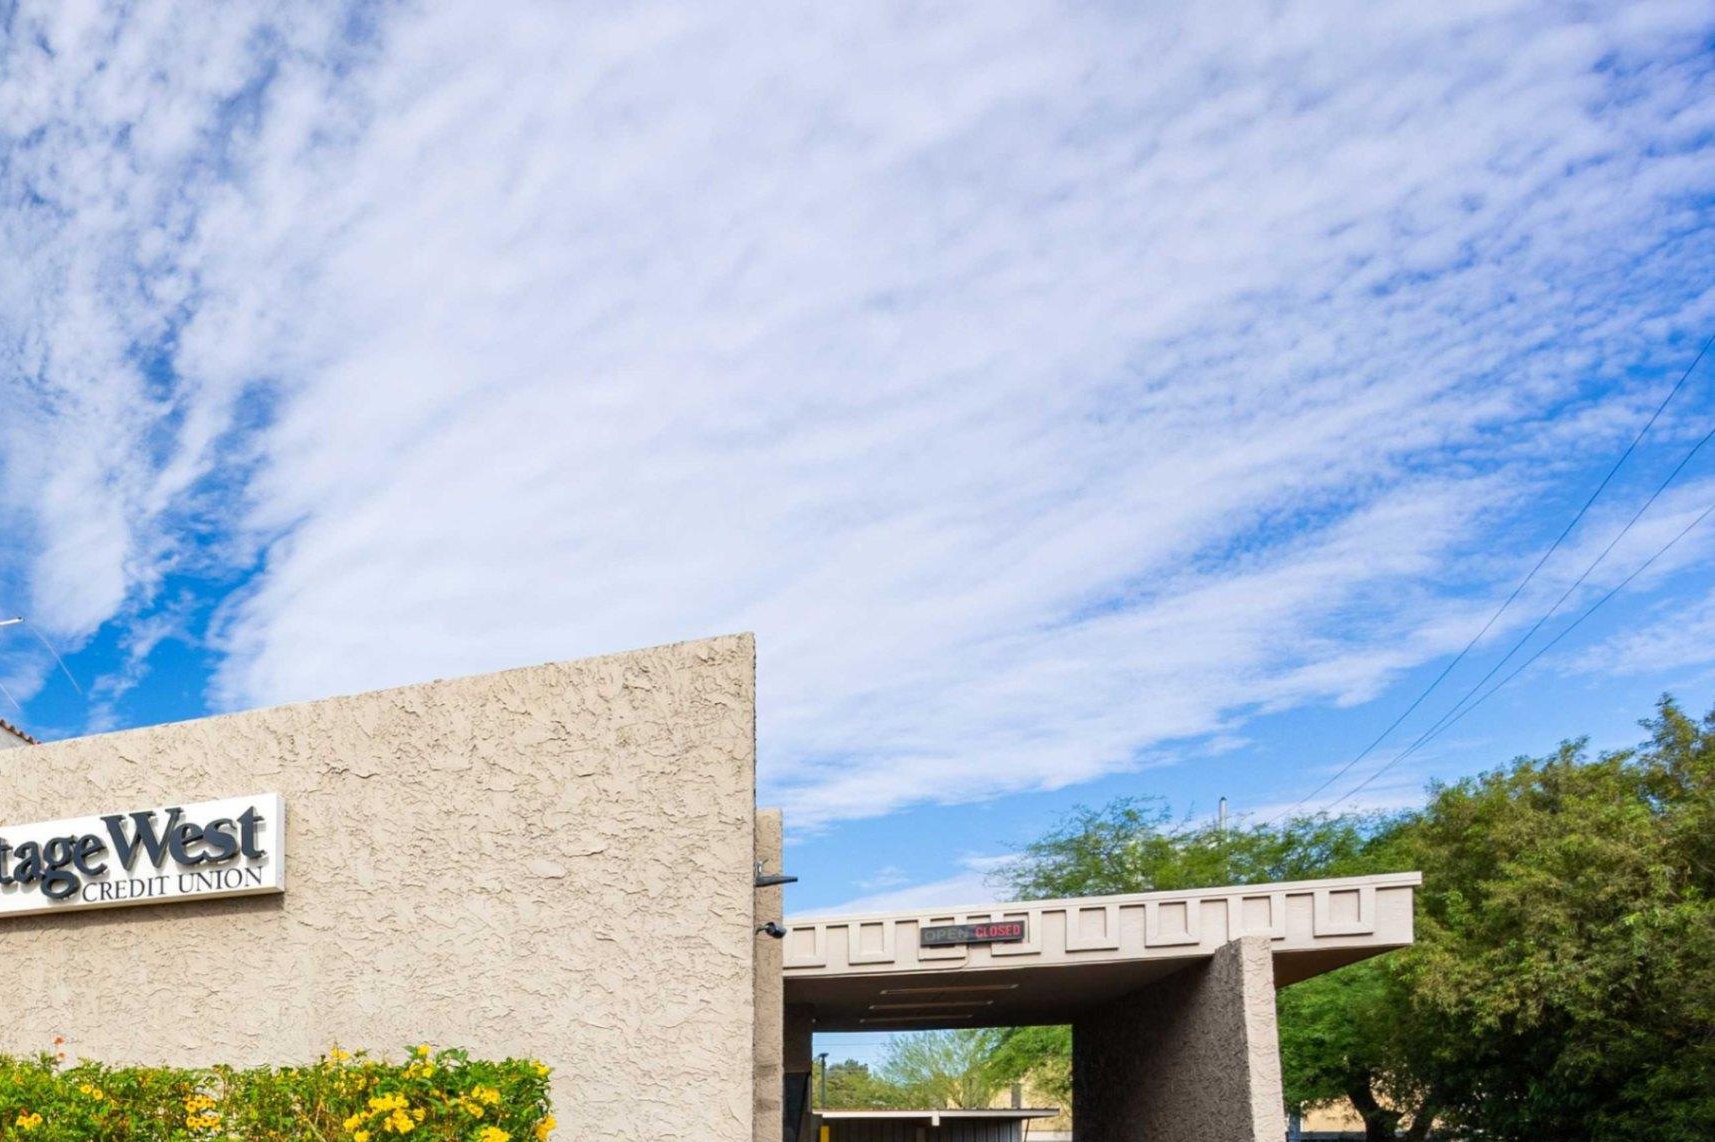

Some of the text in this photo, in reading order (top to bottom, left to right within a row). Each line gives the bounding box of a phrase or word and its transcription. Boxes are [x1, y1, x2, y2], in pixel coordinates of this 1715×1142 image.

[82, 866, 263, 902] CREDIT UNION
[975, 924, 1020, 938] CLOSED
